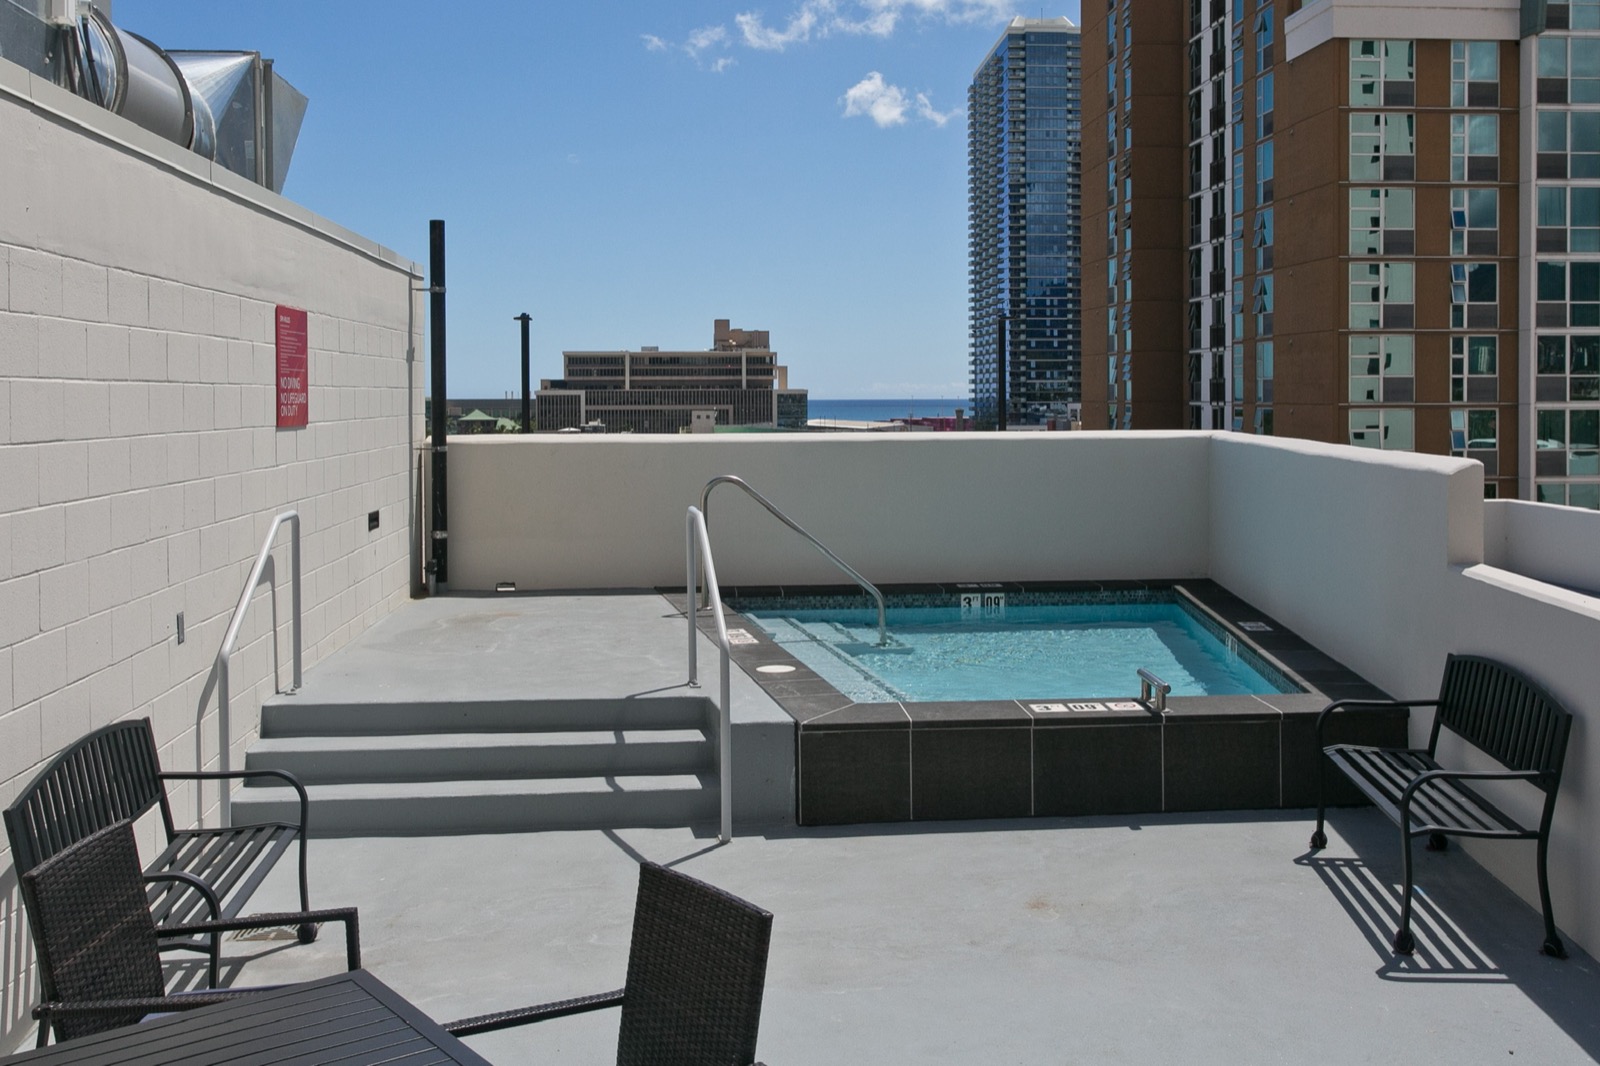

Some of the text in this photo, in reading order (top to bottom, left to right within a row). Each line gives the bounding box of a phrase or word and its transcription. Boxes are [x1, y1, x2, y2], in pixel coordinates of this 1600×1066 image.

[280, 377, 300, 389] NO DIVING
[280, 392, 306, 404] NO LIFEGUARD
[280, 405, 298, 416] ON DUTY
